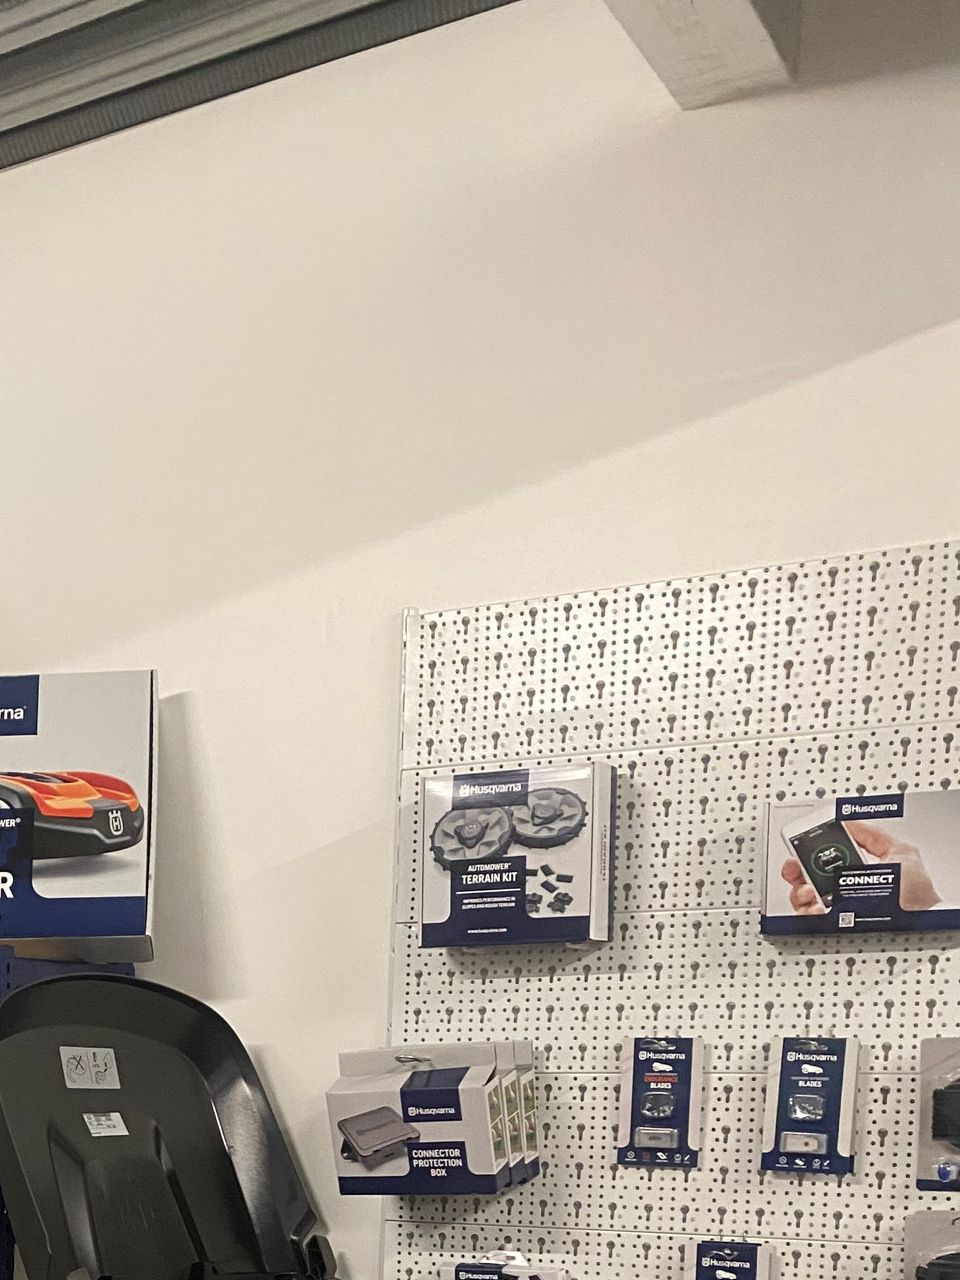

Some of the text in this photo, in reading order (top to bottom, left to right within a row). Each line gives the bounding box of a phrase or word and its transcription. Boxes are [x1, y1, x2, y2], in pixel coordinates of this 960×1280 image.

[470, 782, 522, 796] Husqvarna
[852, 803, 898, 813] Husqvarna
[462, 872, 518, 885] TERRAIN KIT
[839, 874, 895, 885] CONNECT
[647, 1051, 686, 1060] Husqvarna
[796, 1052, 838, 1061] Husqvarna
[798, 1080, 822, 1088] BLADES
[416, 1107, 456, 1116] Husqvarna
[412, 1149, 461, 1158] CONNECTOR
[413, 1159, 463, 1167] PROTECTION
[710, 1260, 751, 1269] Husqvarna
[465, 1272, 499, 1280] Husqvarna
